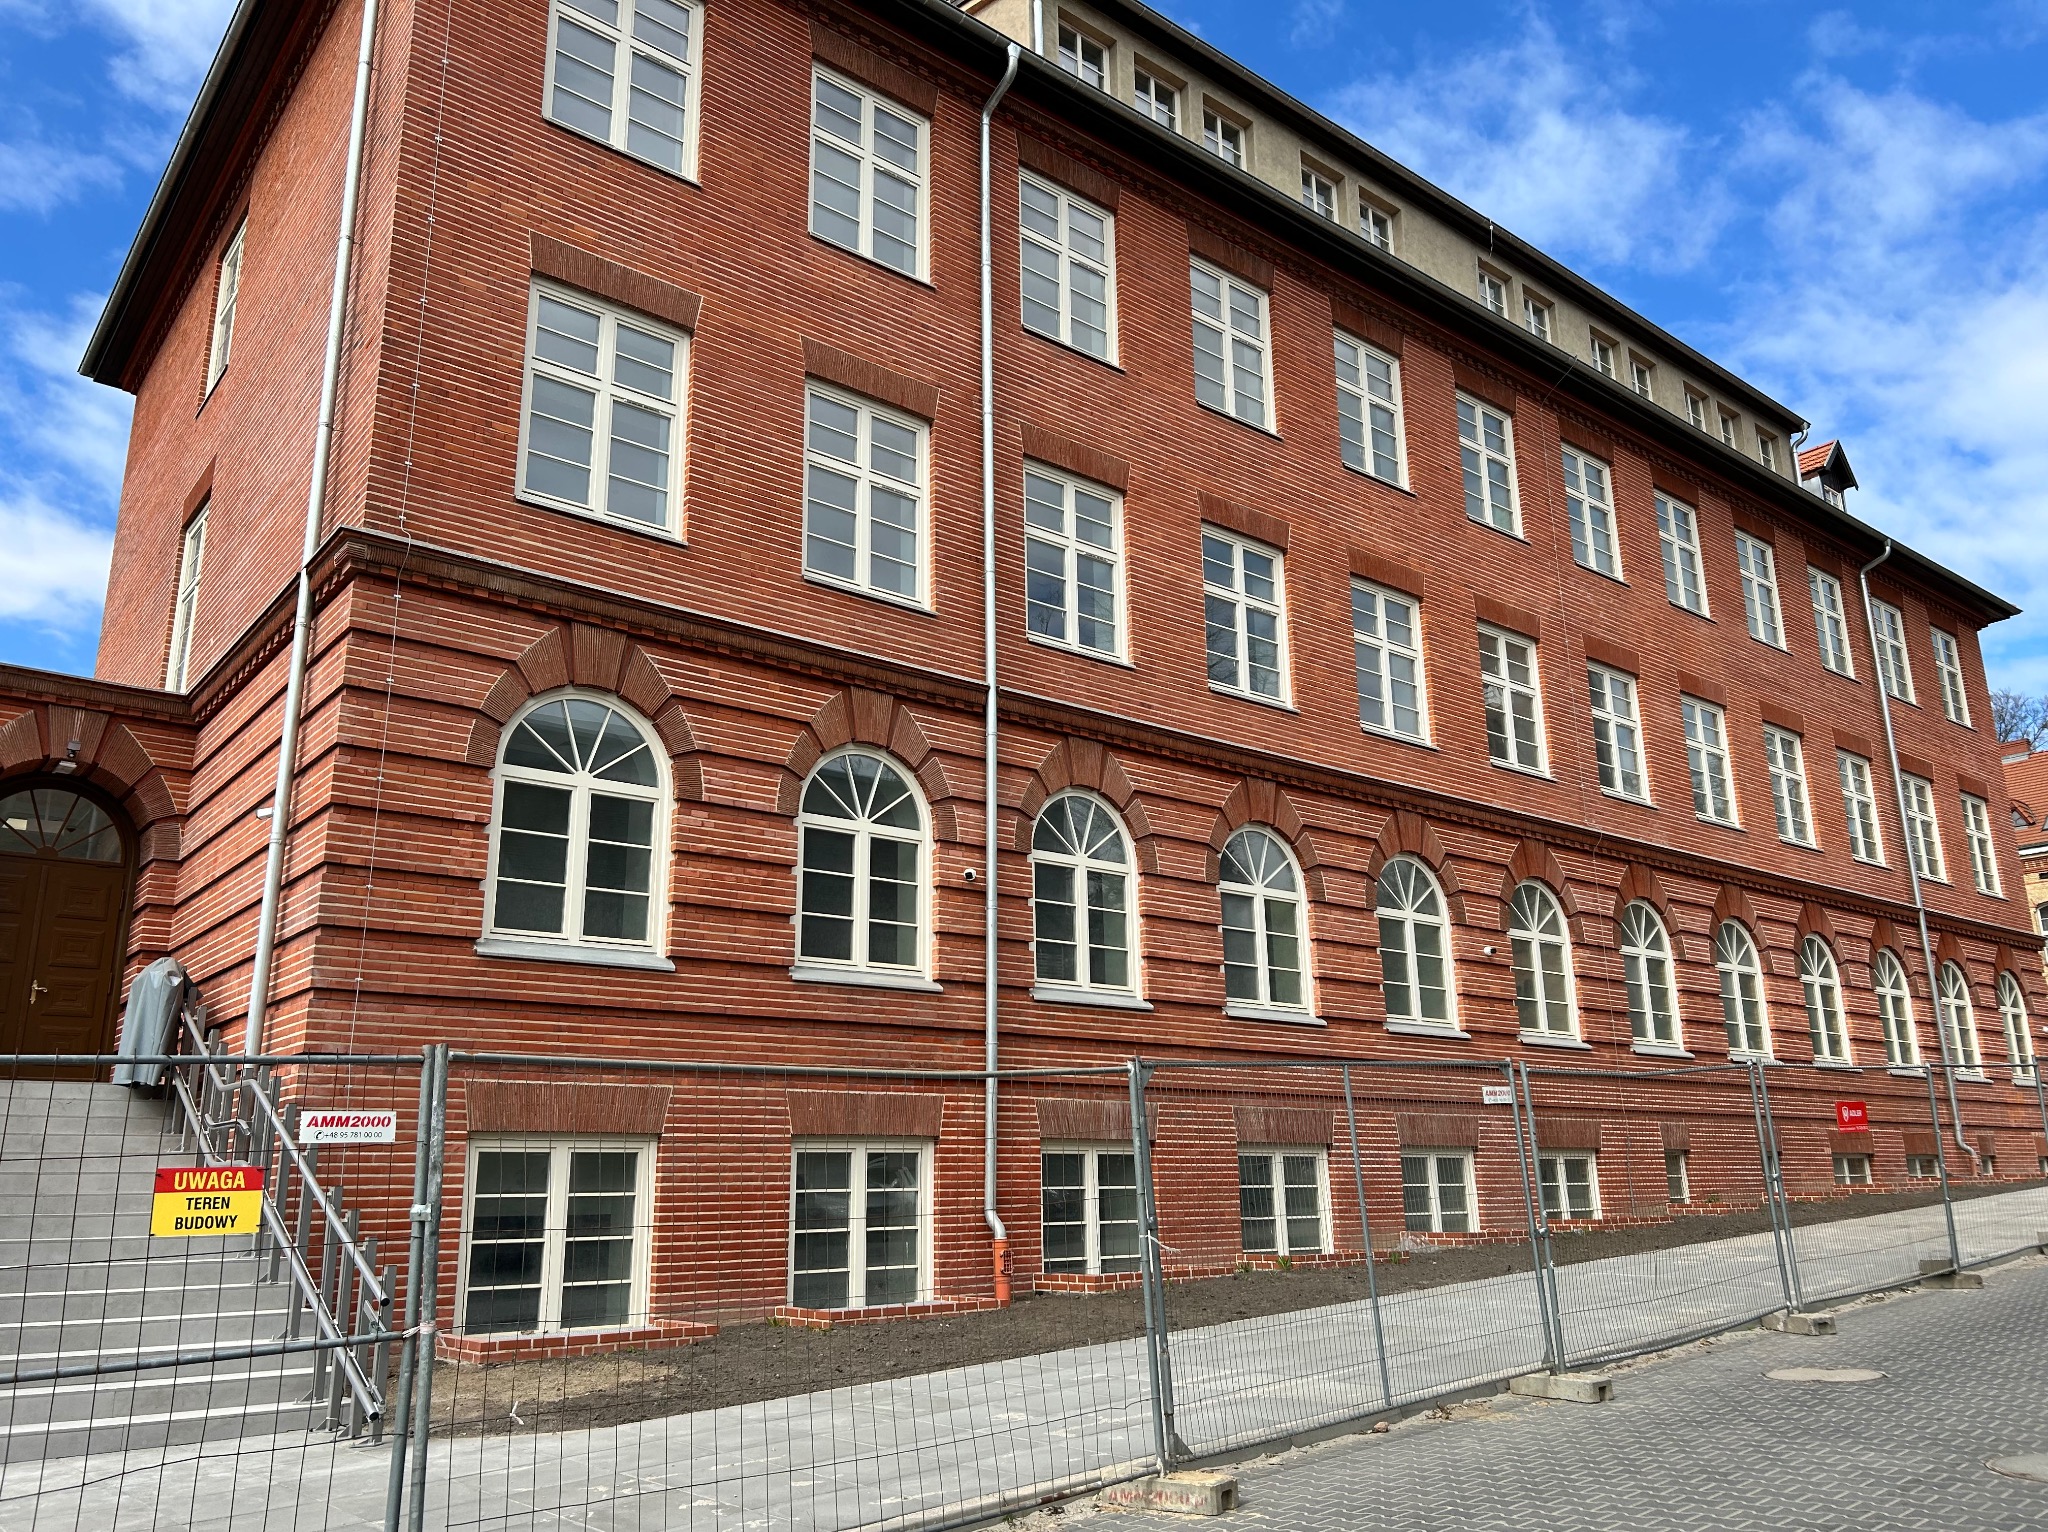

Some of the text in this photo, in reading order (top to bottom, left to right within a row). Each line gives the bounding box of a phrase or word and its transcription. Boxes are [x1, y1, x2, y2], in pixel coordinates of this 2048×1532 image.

[306, 1115, 392, 1128] AMM2000
[324, 1131, 338, 1139] +48
[339, 1131, 349, 1139] 95
[174, 1170, 246, 1190] UWAGA
[185, 1196, 231, 1211] TEREN
[174, 1214, 239, 1231] BUDOWY
